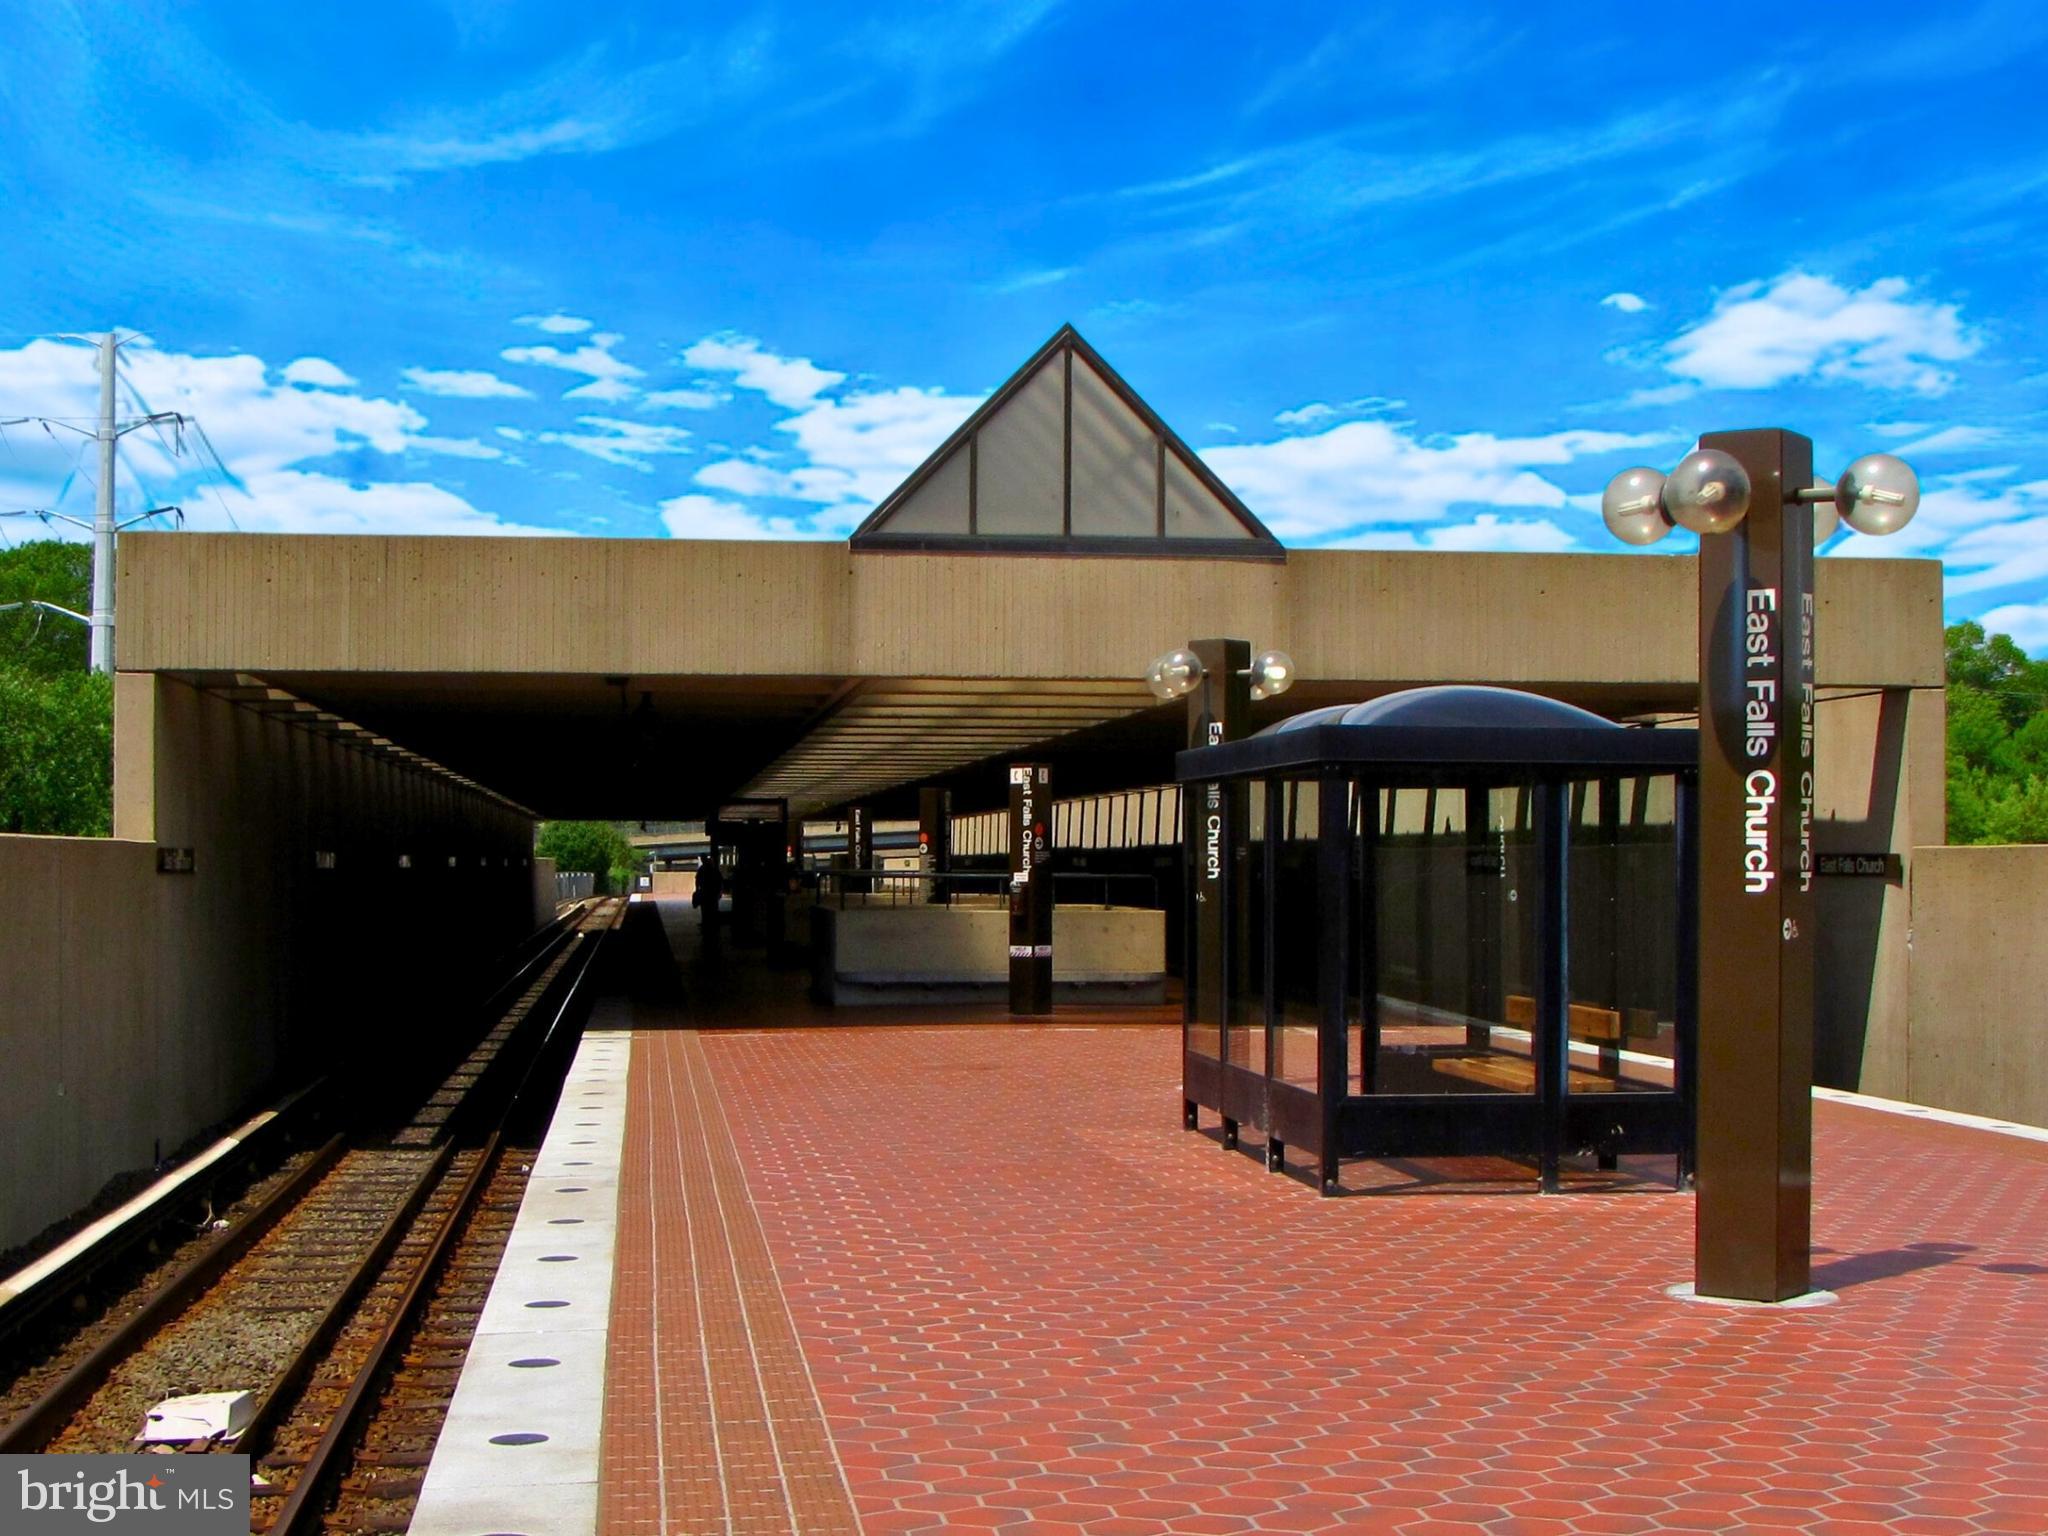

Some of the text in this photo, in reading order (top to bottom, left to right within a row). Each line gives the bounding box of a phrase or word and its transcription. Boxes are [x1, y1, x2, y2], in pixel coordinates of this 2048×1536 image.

[1744, 588, 1776, 894] East Falls Church
[1800, 592, 1814, 892] East Falls Church
[1023, 768, 1033, 873] East Falls Church
[1207, 815, 1221, 879] Church
[1856, 857, 1885, 873] Church
